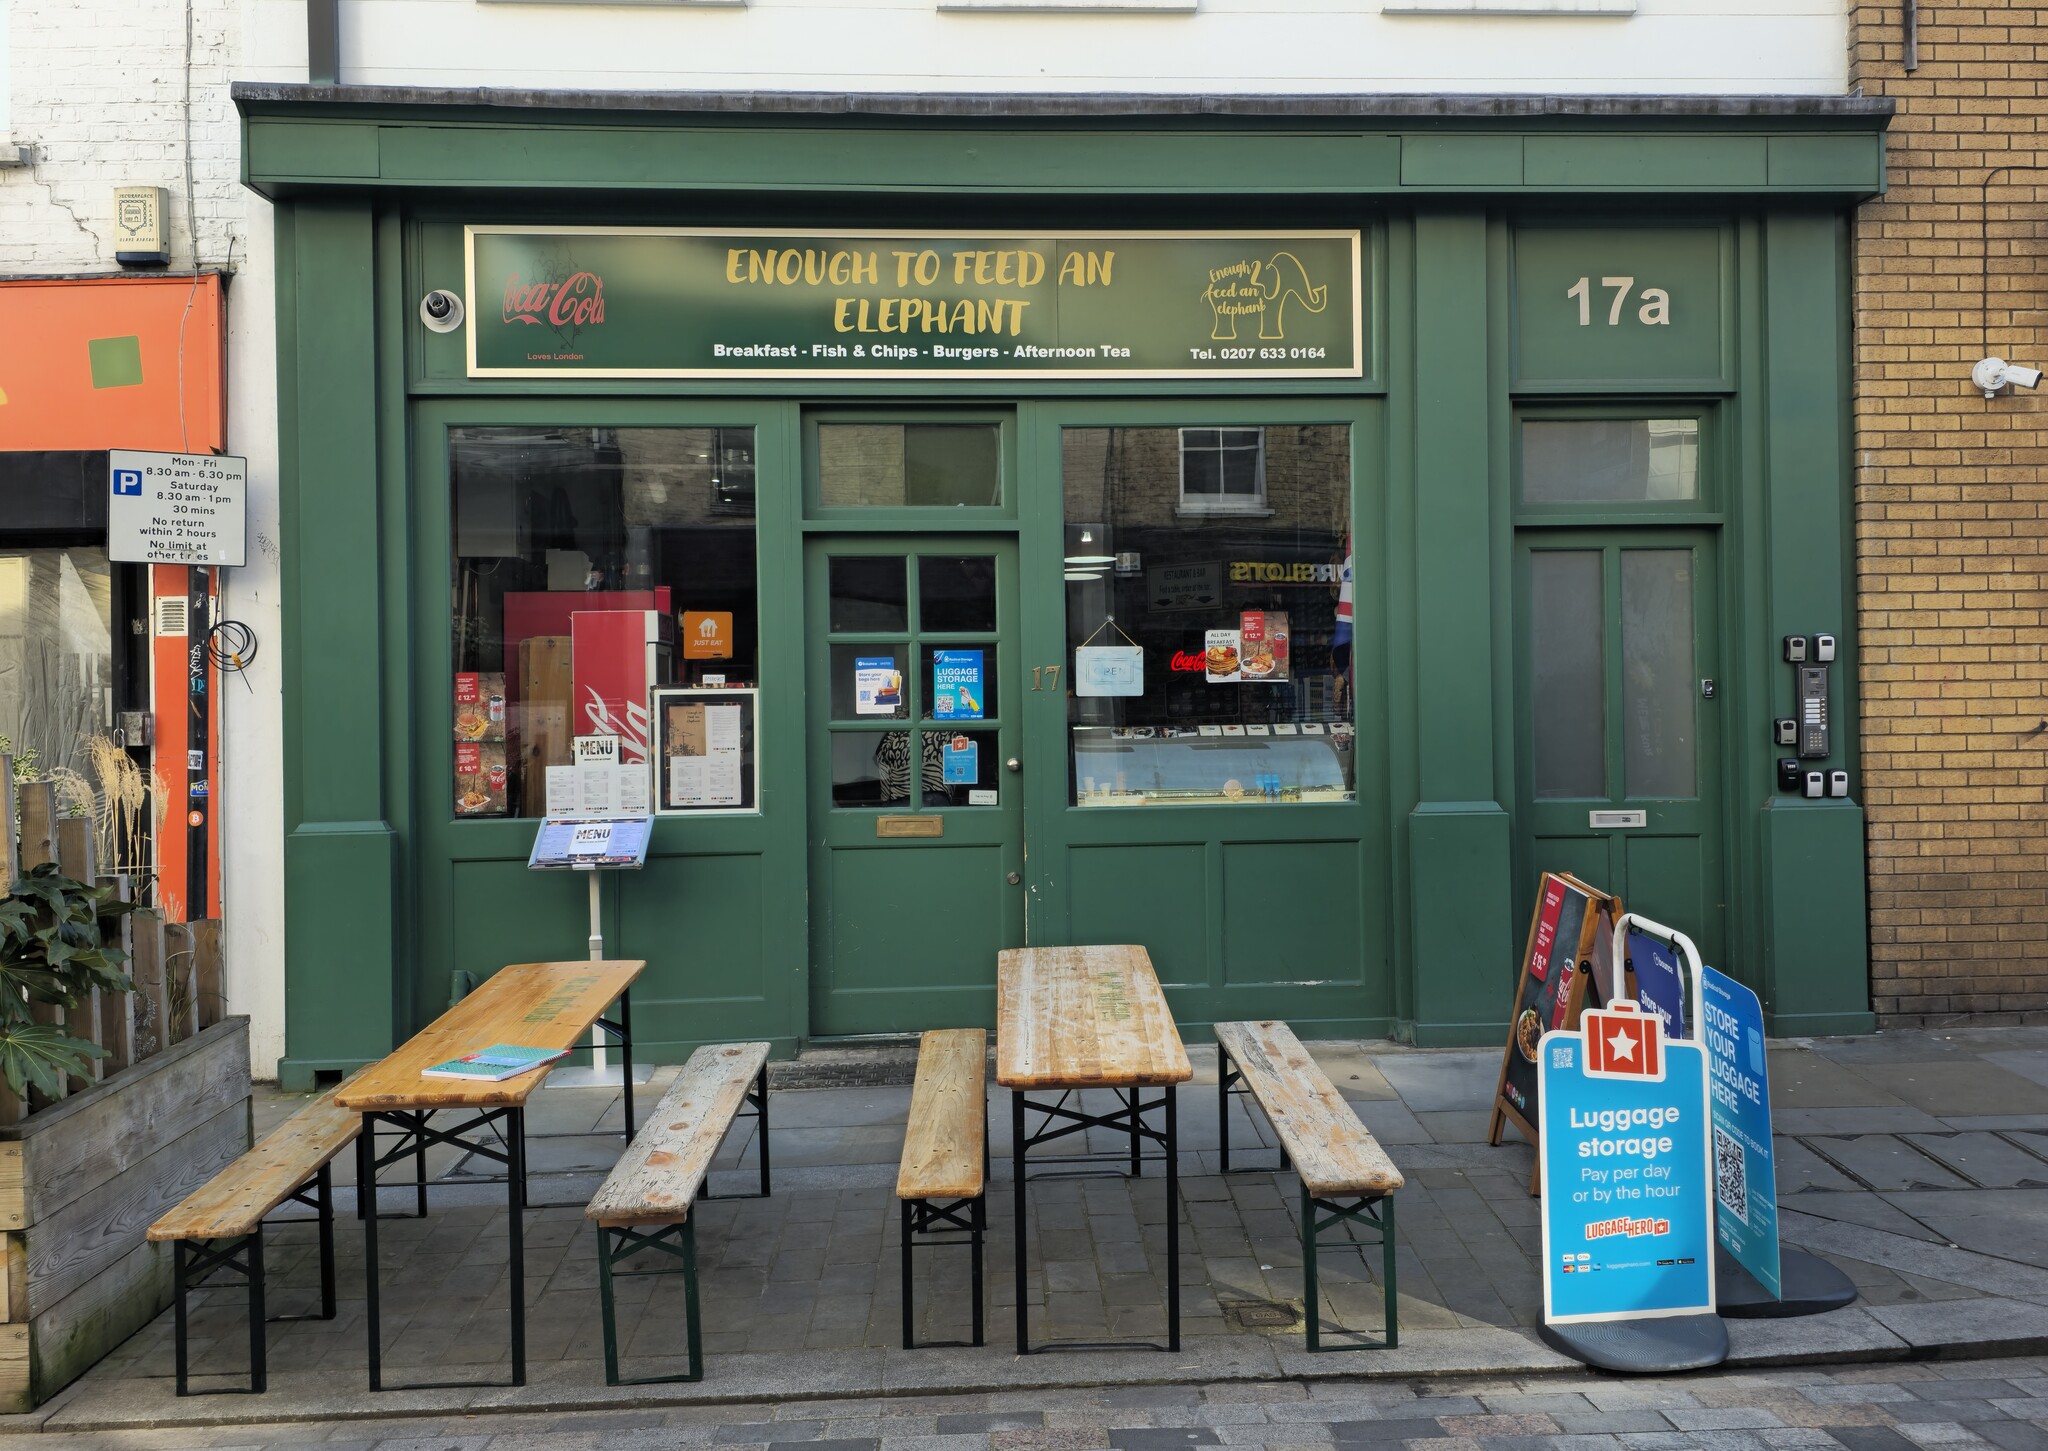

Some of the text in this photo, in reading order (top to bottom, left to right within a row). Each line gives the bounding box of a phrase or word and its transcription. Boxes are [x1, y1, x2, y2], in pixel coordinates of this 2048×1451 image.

[726, 249, 1115, 288] ENOUGH TO FEED AN
[1209, 259, 1251, 284] Enough
[1203, 282, 1259, 300] feed an
[1217, 297, 1266, 315] elephant
[1567, 276, 1670, 326] 17a
[834, 298, 1030, 337] ELEPHANT
[713, 343, 797, 358] Breakfast
[812, 343, 848, 358] Fish
[852, 345, 865, 358] &
[871, 343, 918, 361] Chips
[933, 344, 999, 361] Burgers
[1014, 343, 1096, 359] Afternoon
[1100, 344, 1131, 359] Tea
[1190, 347, 1326, 360] Tel. 0207 633 0164
[172, 457, 195, 467] Mon
[203, 459, 217, 468] Fri
[120, 472, 139, 493] P
[146, 466, 172, 477] 8.30
[198, 470, 224, 479] 6.30
[226, 472, 242, 481] pm
[170, 481, 219, 493] Saturday
[156, 491, 183, 501] 8.30
[215, 496, 231, 504] pm
[173, 505, 216, 515] 30 mins
[152, 517, 205, 527] No return
[139, 527, 217, 538] within 2 hours
[147, 550, 176, 559] other
[149, 540, 207, 551] No limit at
[937, 667, 978, 676] LUGGAGE
[937, 675, 978, 683] STORAGE
[1032, 665, 1060, 691] 17
[580, 740, 613, 755] MENU
[576, 828, 611, 840] MENU
[1657, 957, 1674, 974] bounce
[1641, 988, 1657, 1014] Store
[1704, 1001, 1740, 1041] STORE
[1706, 1025, 1736, 1064] YOUR
[1709, 1052, 1761, 1106] LUGGAGE
[1711, 1077, 1739, 1115] HERE
[1570, 1106, 1680, 1132] Luggage
[1578, 1136, 1673, 1159] storage
[1581, 1163, 1671, 1184] Pay per day
[1573, 1183, 1681, 1204] or by the hour
